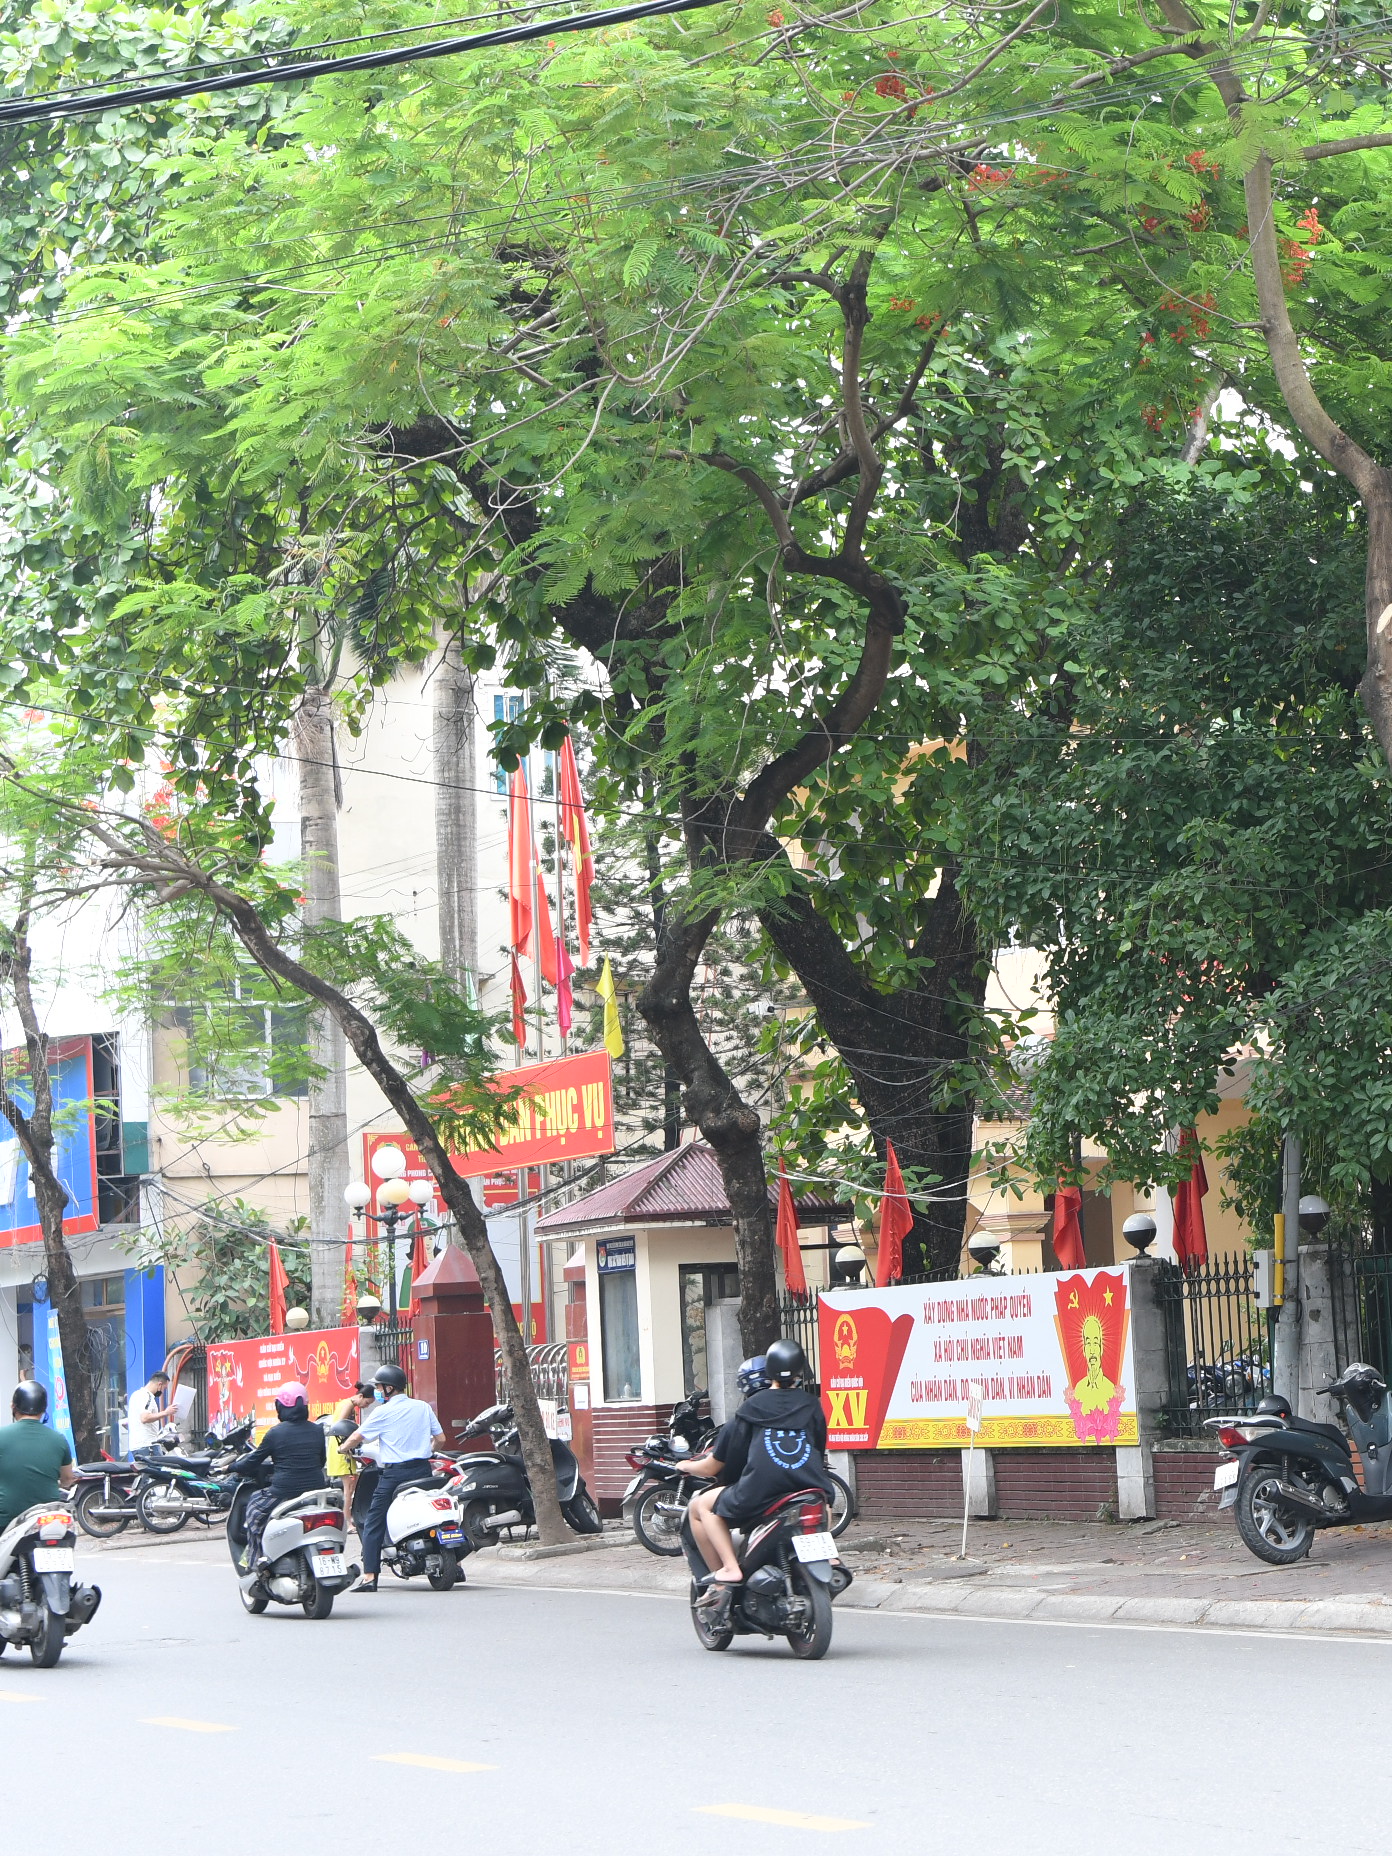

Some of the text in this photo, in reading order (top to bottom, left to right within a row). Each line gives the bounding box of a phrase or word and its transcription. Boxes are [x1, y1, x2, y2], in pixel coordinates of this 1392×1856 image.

[535, 1087, 578, 1144] PHỤC
[582, 1082, 605, 1139] VỤ
[990, 1291, 1008, 1321] PHÁP
[1007, 1335, 1024, 1360] NAM
[960, 1378, 970, 1402] DO
[826, 1390, 869, 1428] XV
